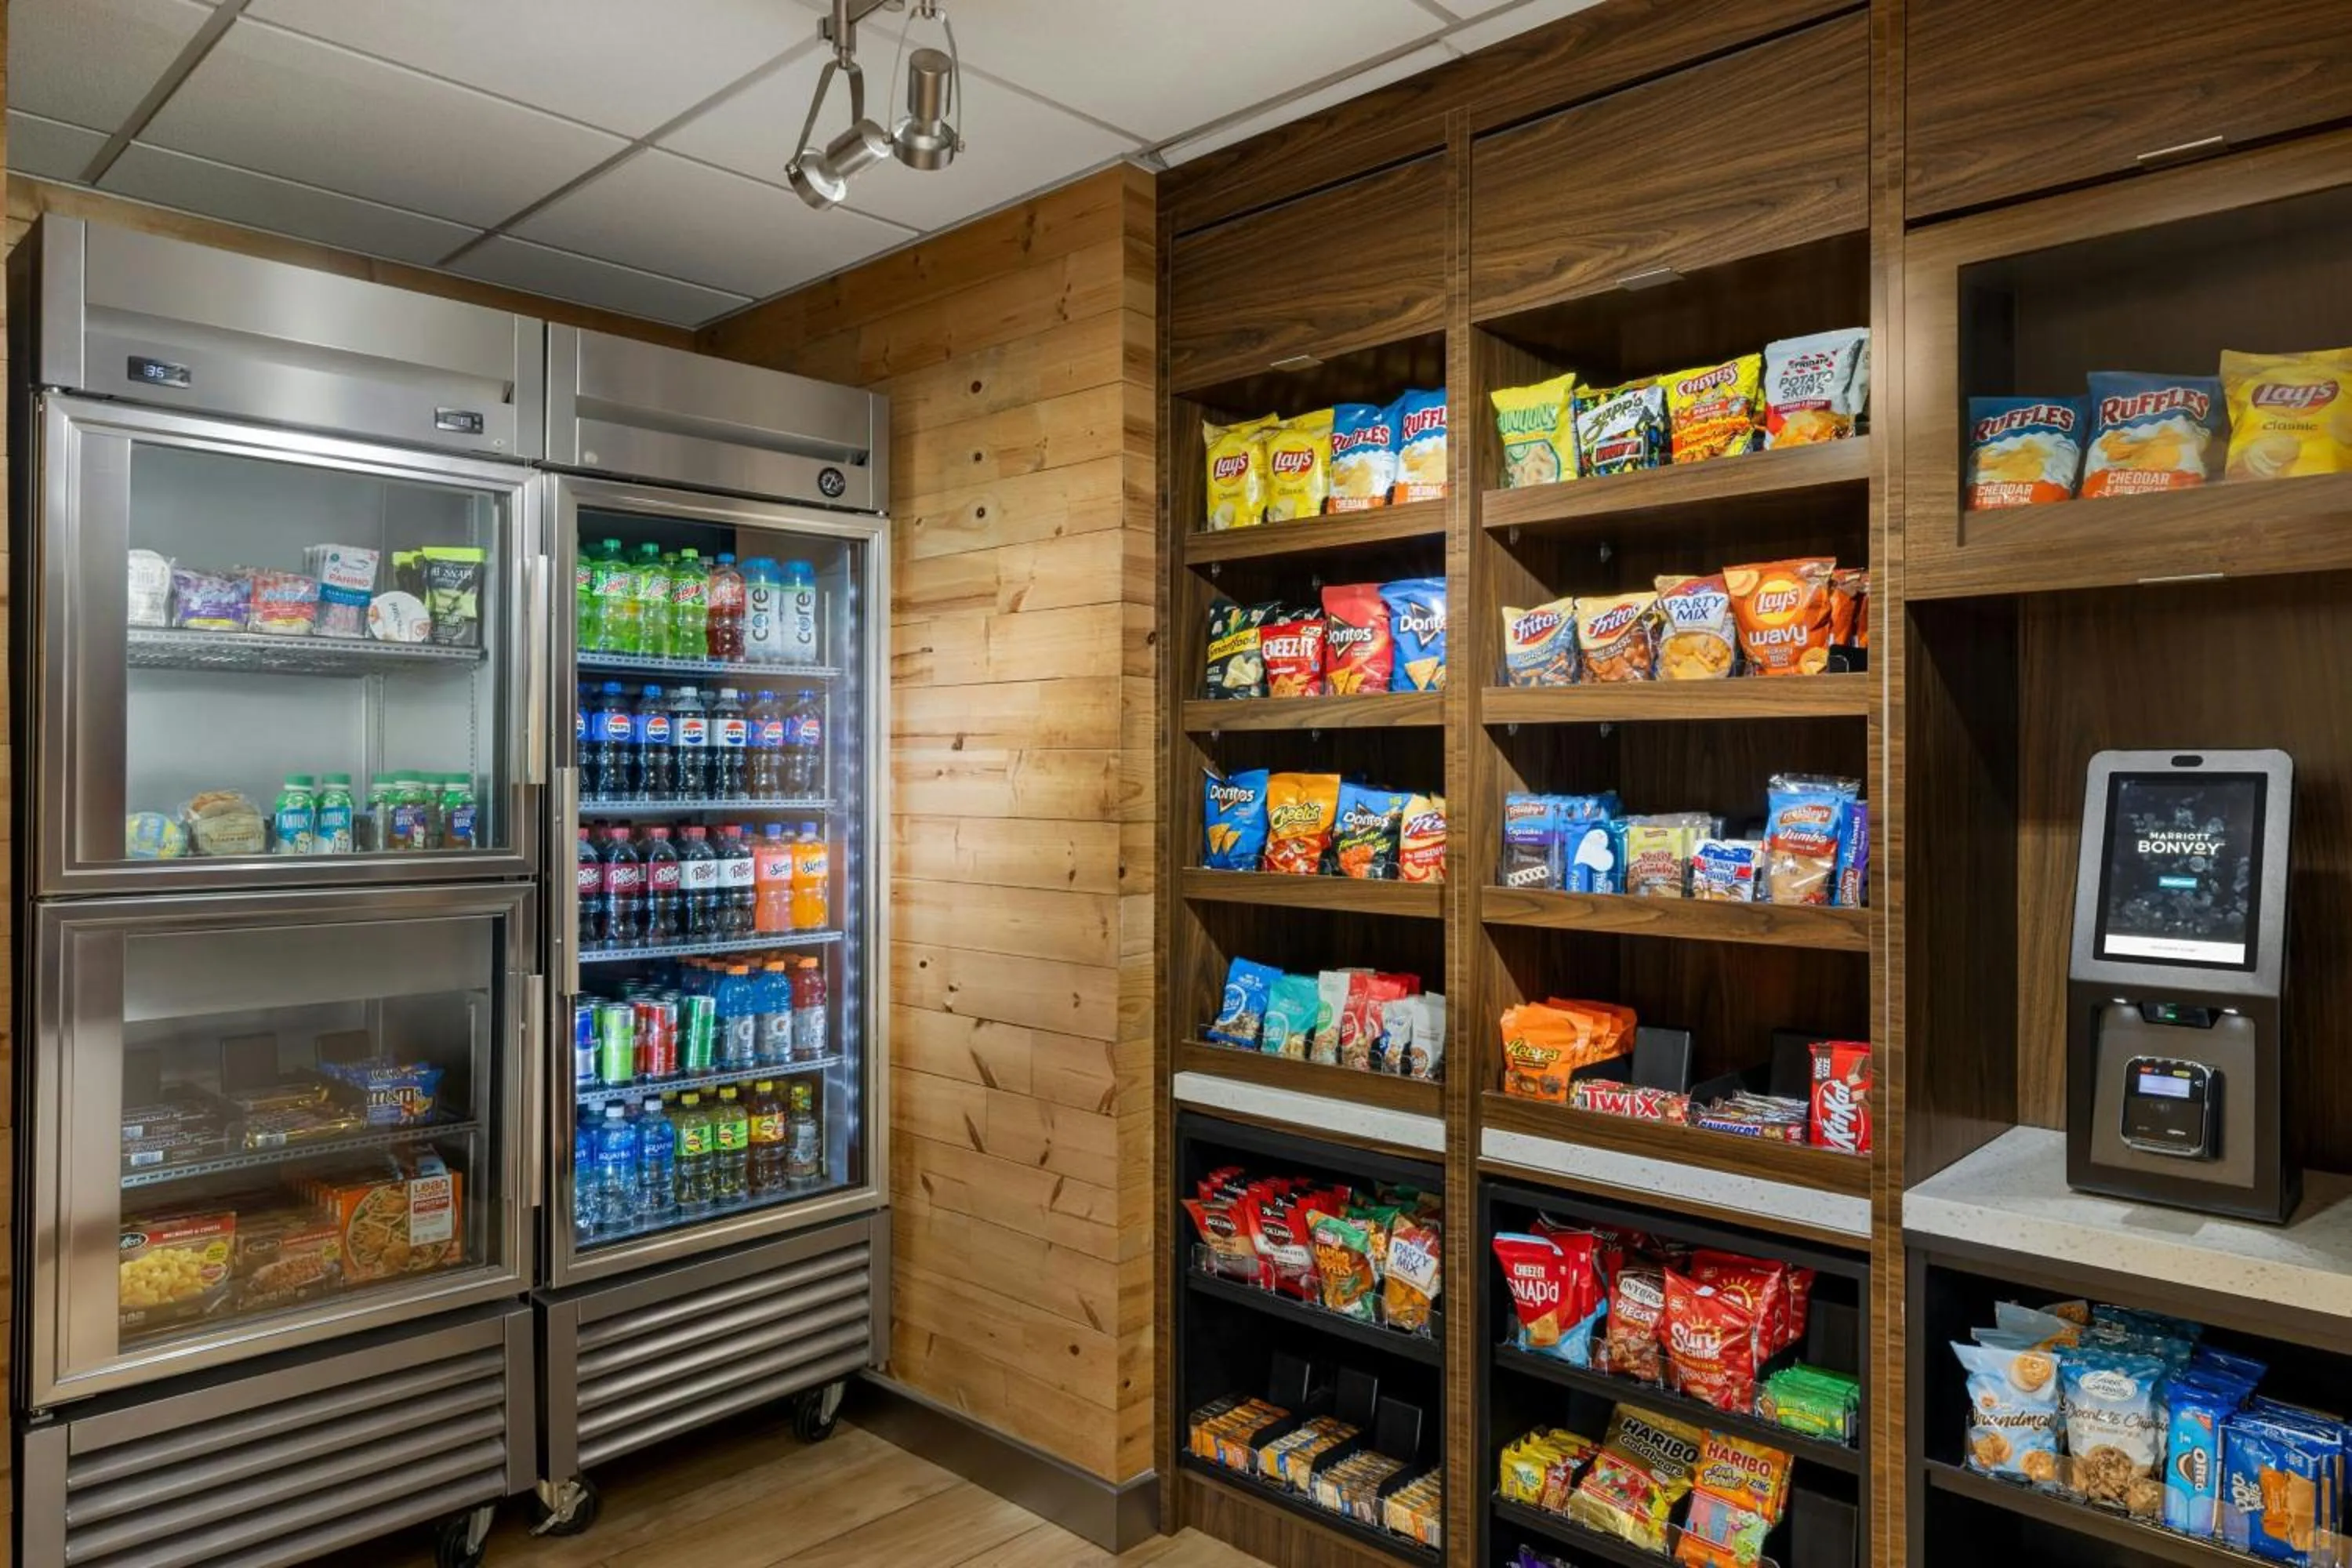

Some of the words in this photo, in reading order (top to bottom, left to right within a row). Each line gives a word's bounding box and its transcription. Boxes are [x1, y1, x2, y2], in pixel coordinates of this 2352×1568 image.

[1780, 371, 1834, 389] POTATO
[1782, 384, 1826, 399] SKINS
[2099, 387, 2211, 426] RUFFLES
[2254, 380, 2339, 408] Lay's
[1403, 406, 1446, 439] RUFFL
[1973, 405, 2074, 442] RUFFLES
[2262, 419, 2318, 432] Classic
[1331, 424, 1389, 456] RUFFLES
[1215, 452, 1249, 478] Lay's
[1273, 449, 1313, 474] Lay's
[1976, 485, 2033, 496] CHEDDAR
[2107, 473, 2170, 485] CHEDDAR
[328, 573, 369, 587] PANINO
[1668, 596, 1725, 611] PARTY
[1757, 589, 1799, 614] Lay's
[752, 588, 769, 642] core
[797, 592, 811, 644] core
[1588, 603, 1641, 637] Fritos
[1675, 608, 1709, 622] MIX
[1512, 612, 1563, 645] Fritos
[1748, 623, 1808, 647] wavy
[1210, 785, 1255, 803] Doritos
[281, 813, 308, 829] MILK
[320, 811, 347, 829] MILK
[1270, 803, 1321, 830] Cheetos
[1343, 811, 1390, 829] Doritos
[1778, 828, 1828, 844] Jumbo
[2137, 840, 2220, 855] BONVOY
[2149, 832, 2211, 841] MARRIOTT
[1580, 1084, 1662, 1120] TWIX
[1394, 1241, 1432, 1268] PARTY
[1396, 1255, 1420, 1276] MIX
[1621, 1417, 1701, 1464] HARIBO
[1619, 1434, 1686, 1478] Goldbears
[1706, 1441, 1773, 1478] HARIBO
[2192, 1447, 2208, 1493] OREO
